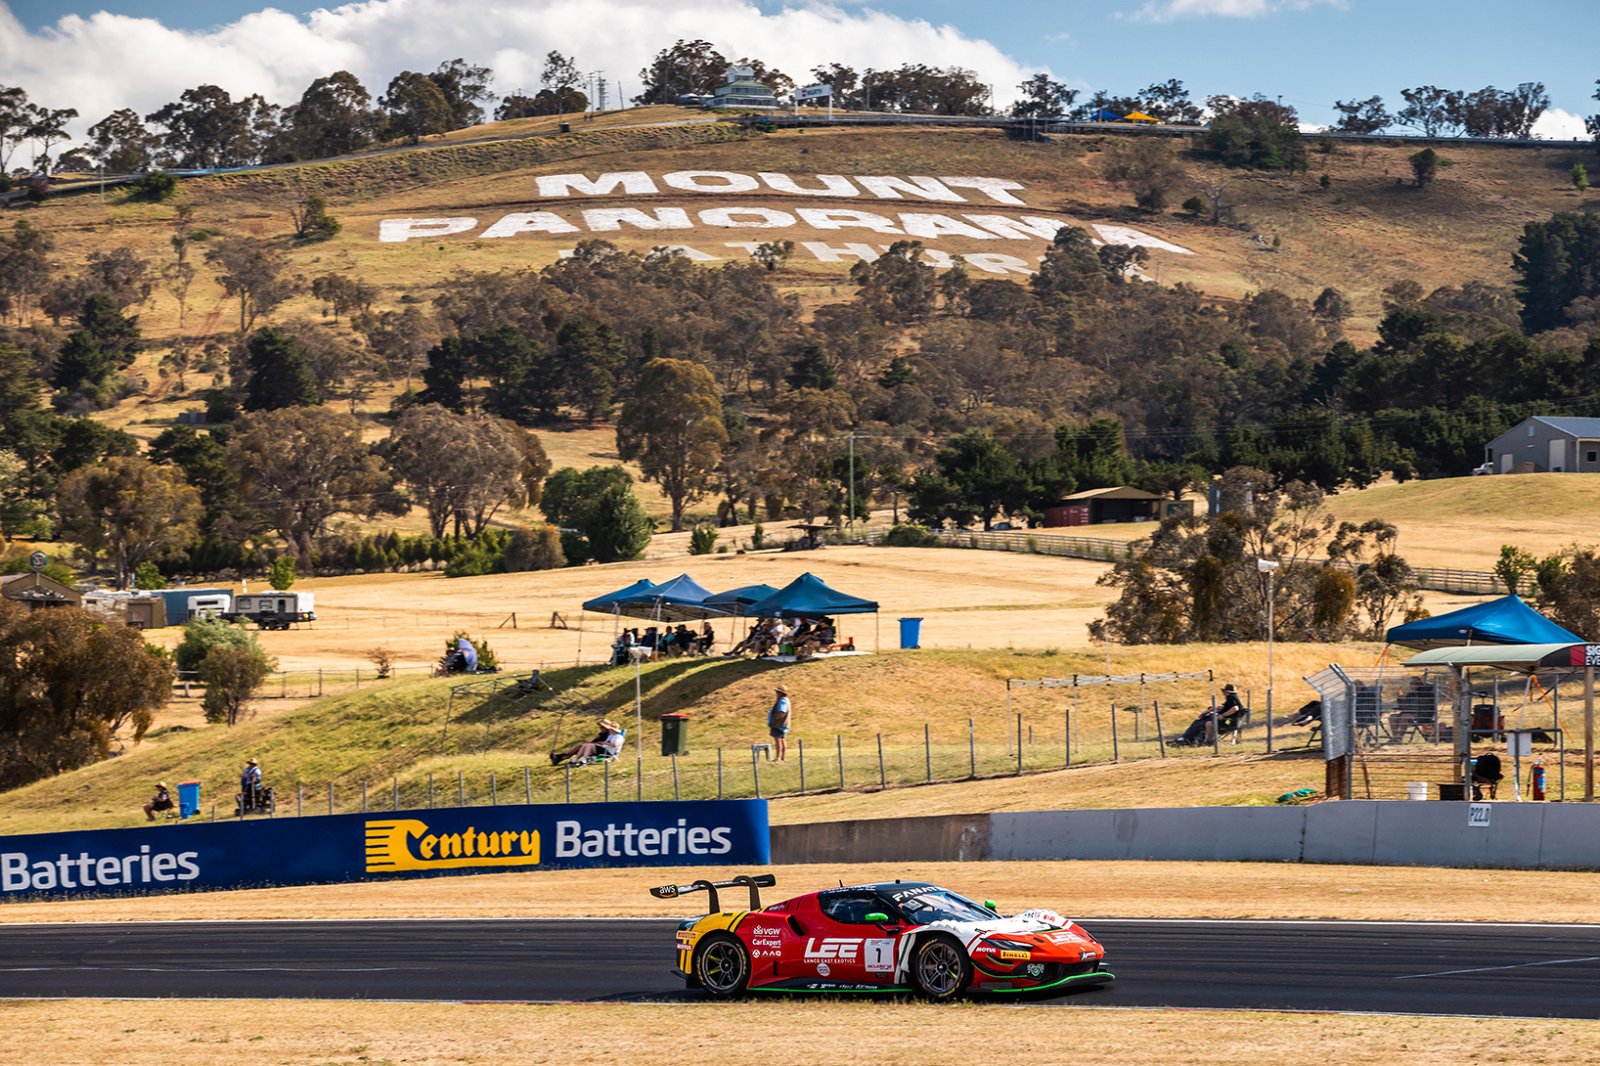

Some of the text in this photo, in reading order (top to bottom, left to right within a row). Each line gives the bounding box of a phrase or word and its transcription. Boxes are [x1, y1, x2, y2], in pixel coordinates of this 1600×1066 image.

[534, 170, 1027, 206] MOUNT
[378, 206, 1198, 256] PANORAMA
[365, 818, 732, 873] Century Batteries
[0, 844, 200, 892] Batteries
[659, 885, 676, 894] aws
[752, 938, 781, 947] CarExpert
[804, 938, 864, 958] LEE
[875, 947, 882, 964] 1
[1002, 951, 1029, 959] PIRELLI
